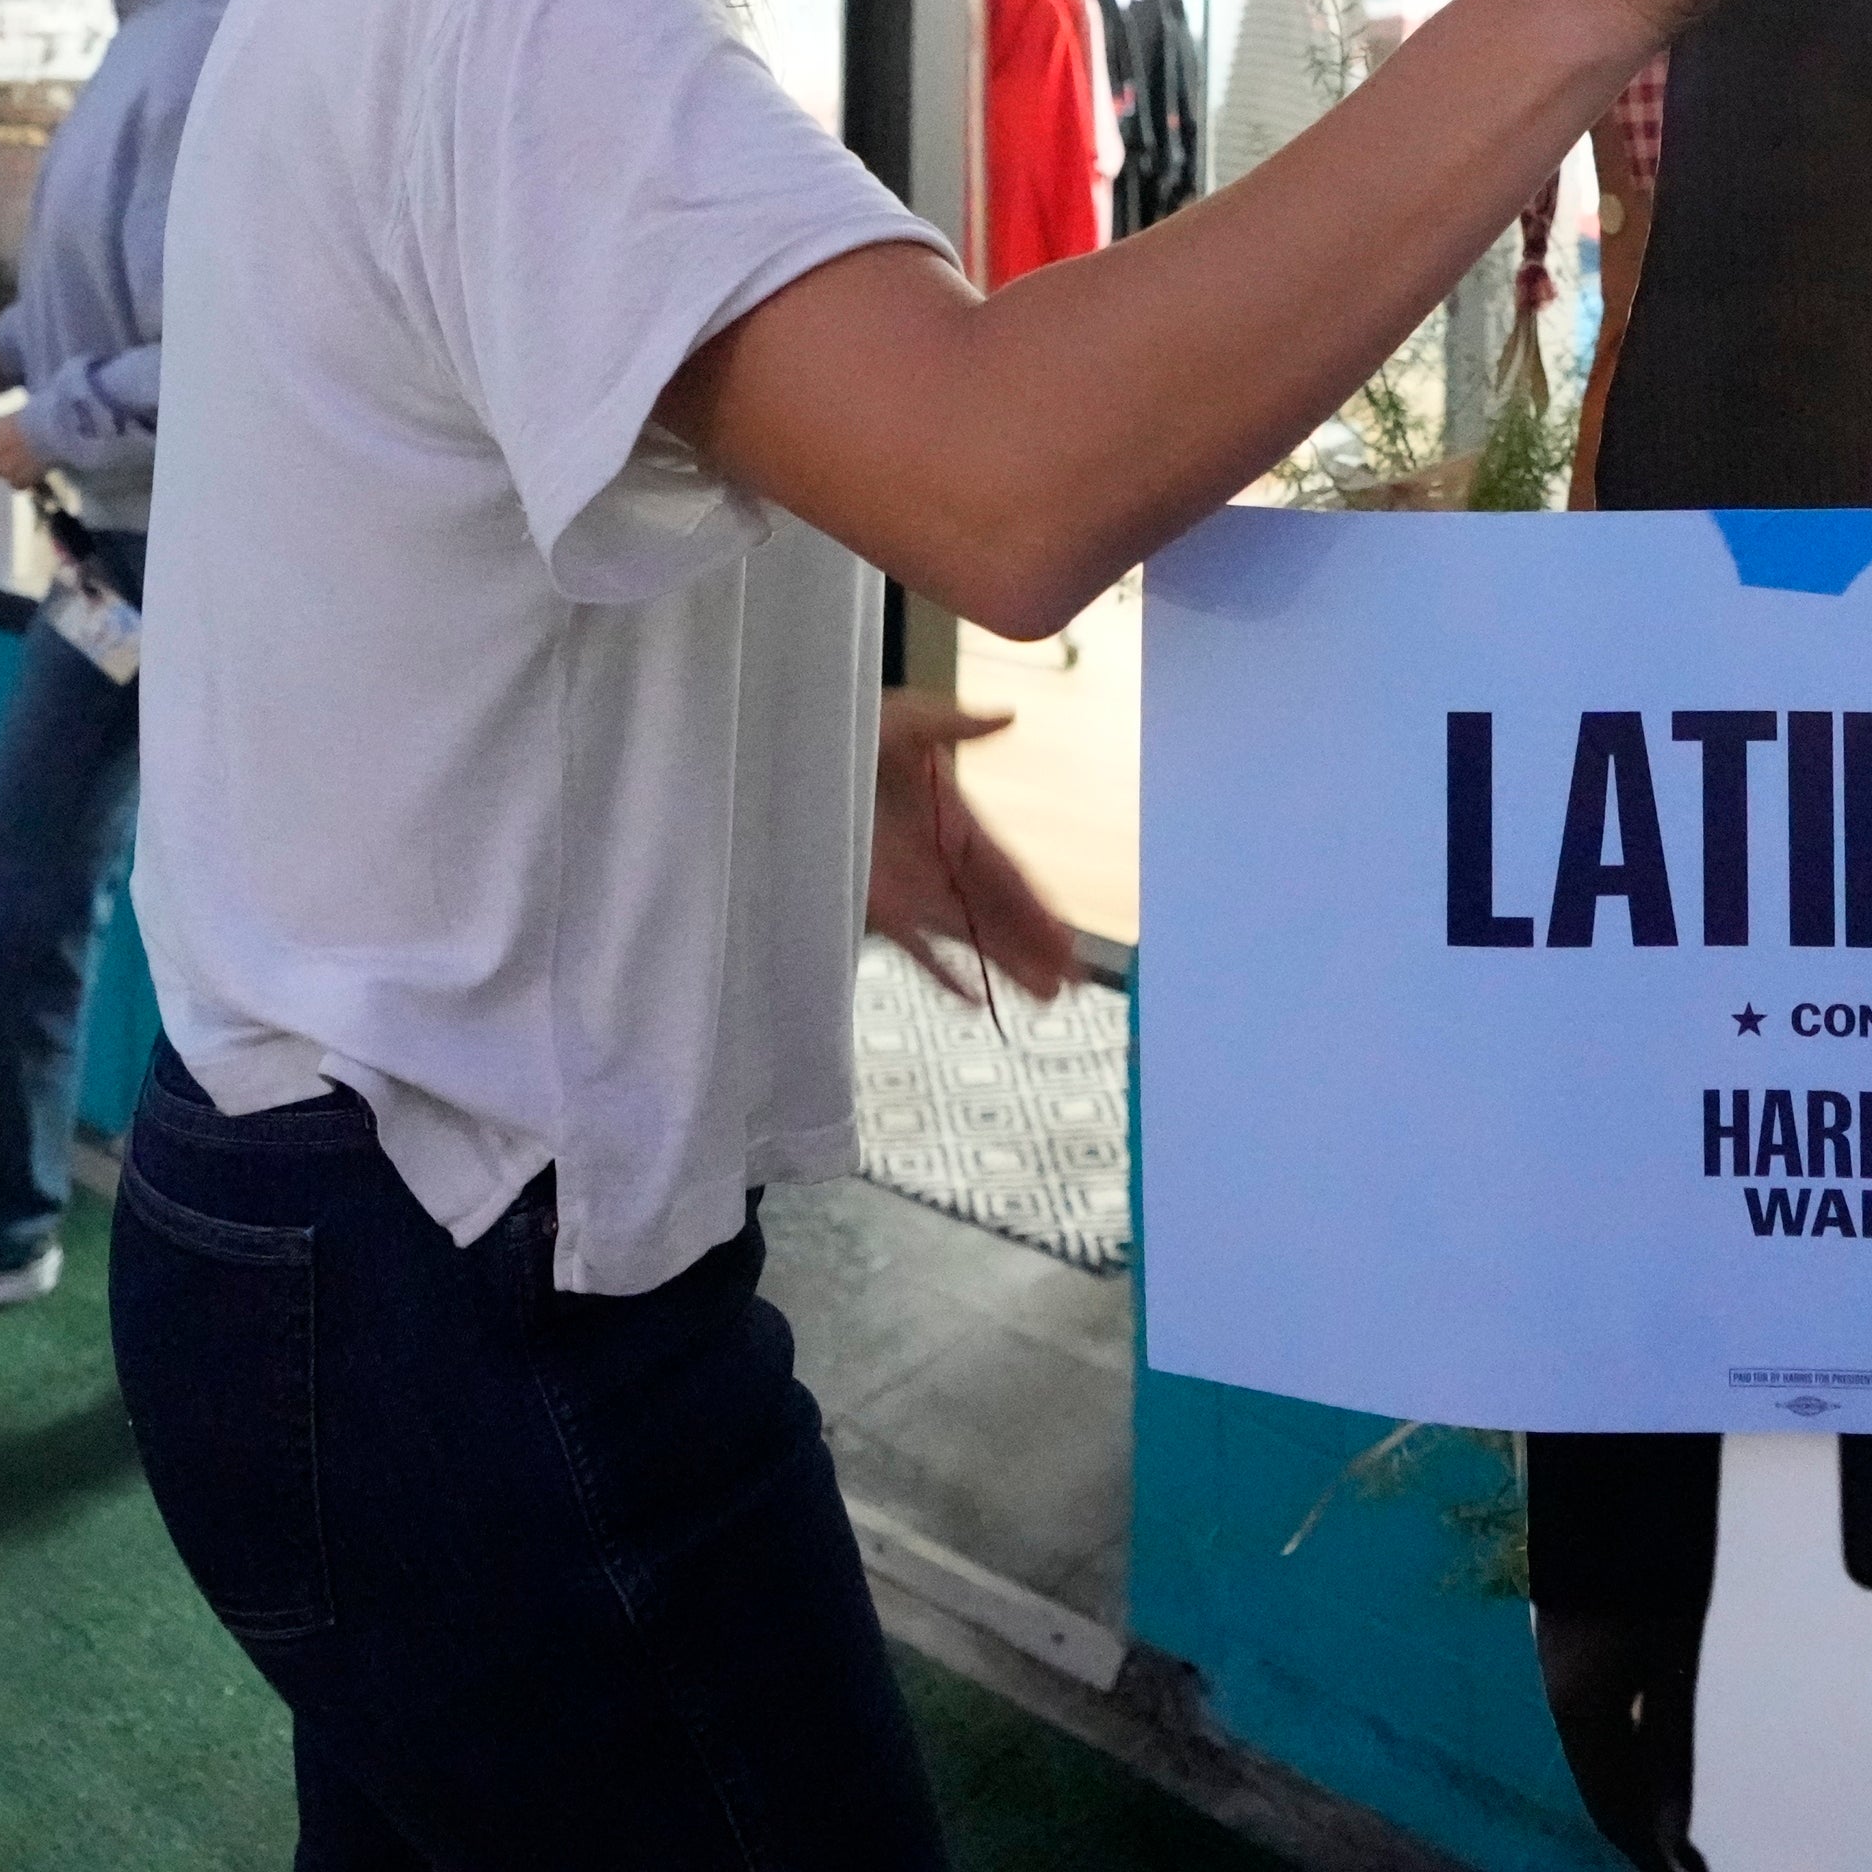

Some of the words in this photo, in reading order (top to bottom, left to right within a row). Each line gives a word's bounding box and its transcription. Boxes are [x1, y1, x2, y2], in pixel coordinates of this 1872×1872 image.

[1732, 1372, 1752, 1384] PAID
[1753, 1372, 1768, 1384] FOR
[1770, 1372, 1781, 1383] BY
[1782, 1373, 1814, 1384] HARRIS
[1814, 1373, 1829, 1384] FOR
